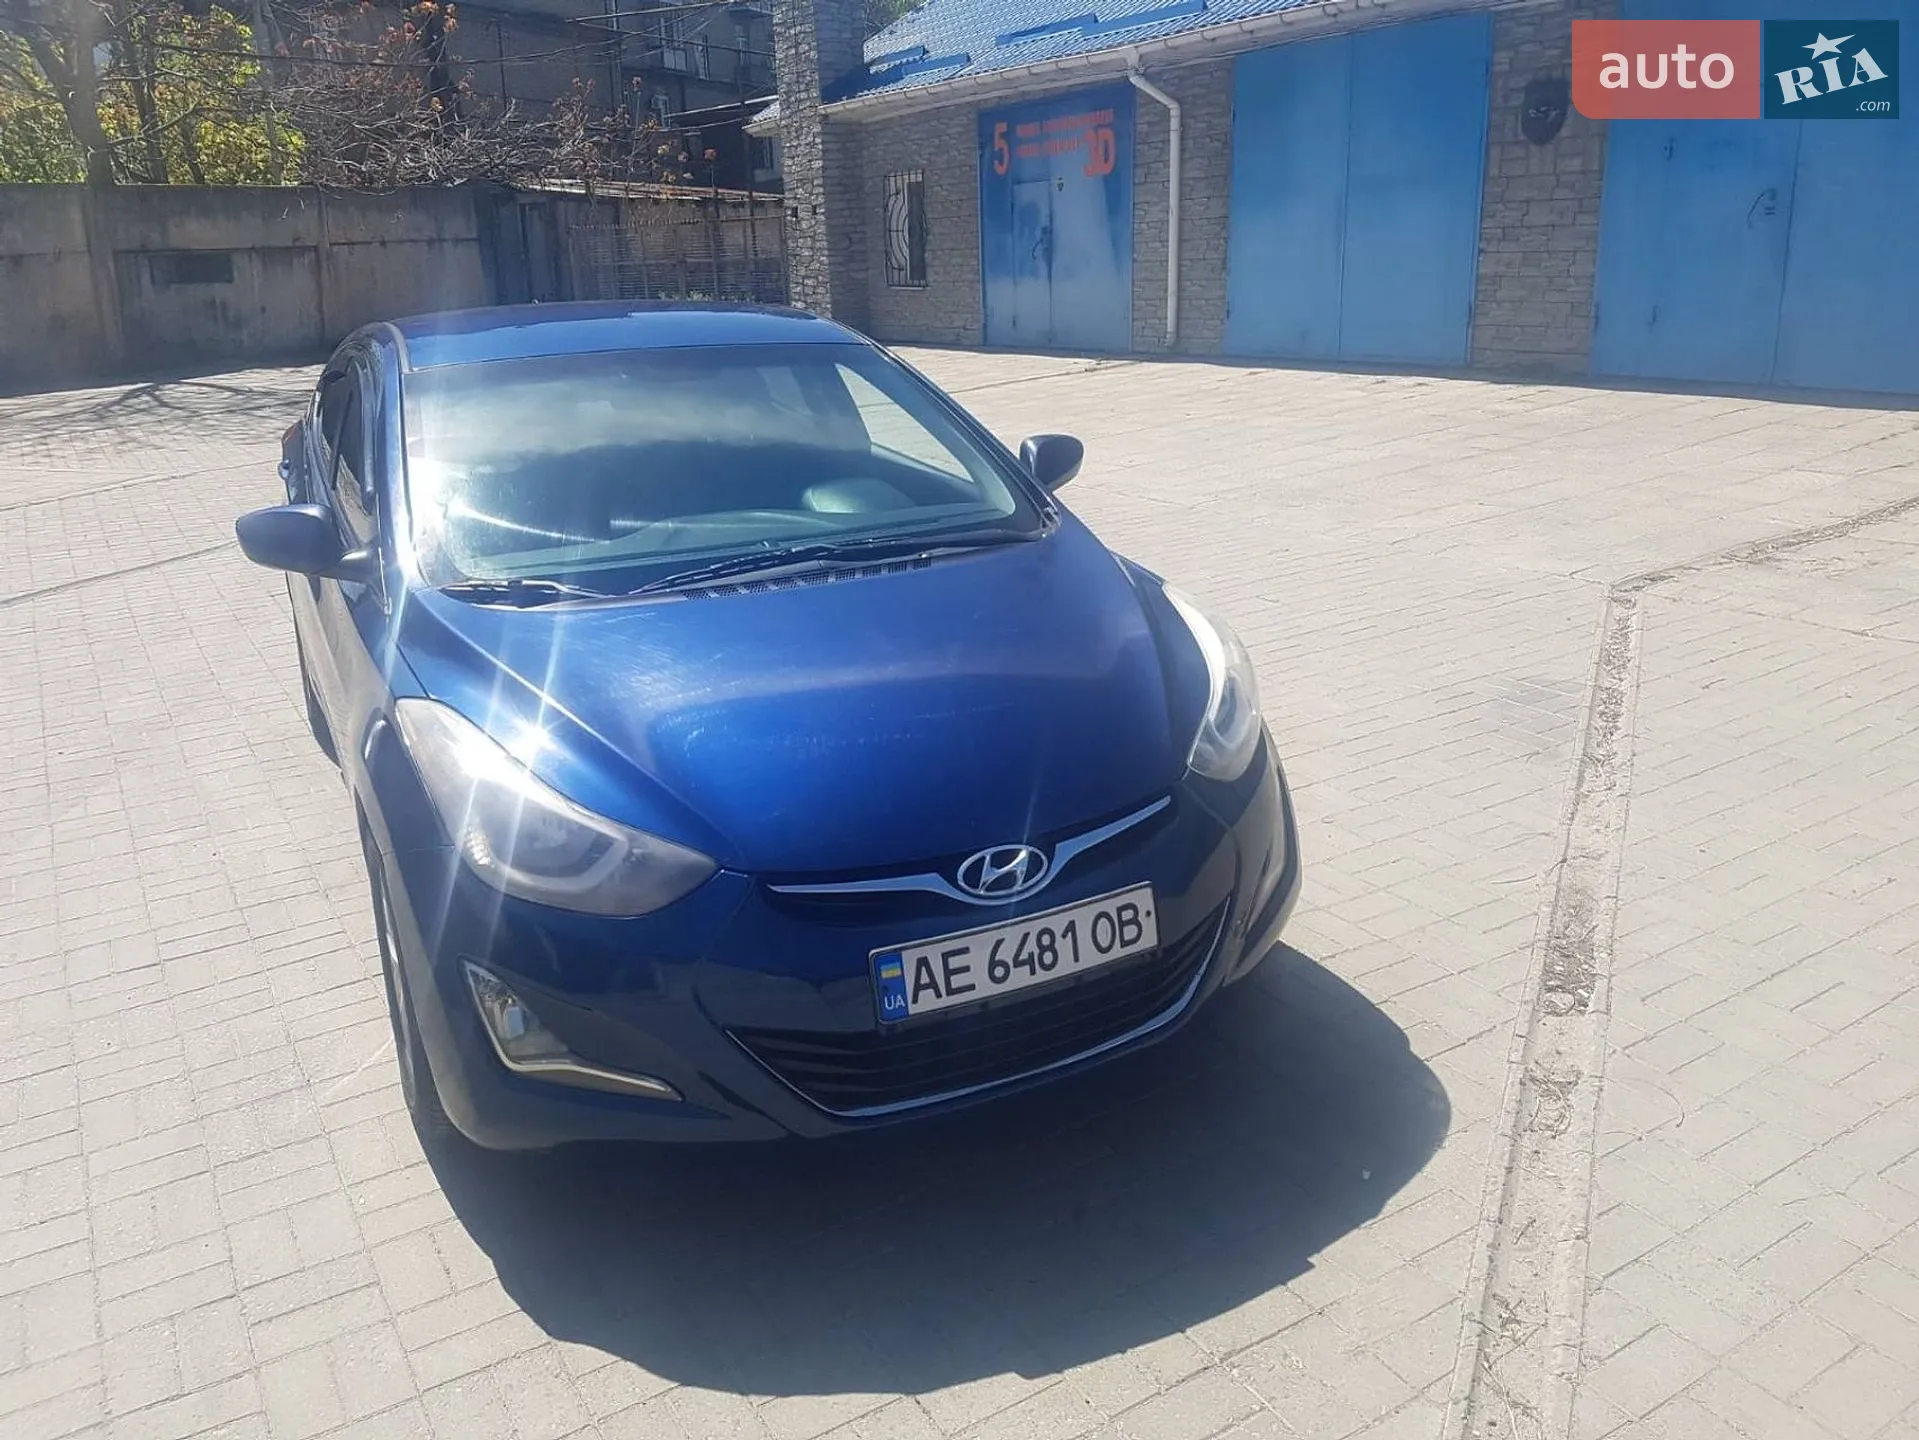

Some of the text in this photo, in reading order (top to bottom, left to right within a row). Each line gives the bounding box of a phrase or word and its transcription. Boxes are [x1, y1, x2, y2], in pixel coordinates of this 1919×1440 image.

[993, 122, 1011, 176] 5
[911, 902, 1143, 1004] AE 6481 OB
[884, 994, 906, 1010] UA
